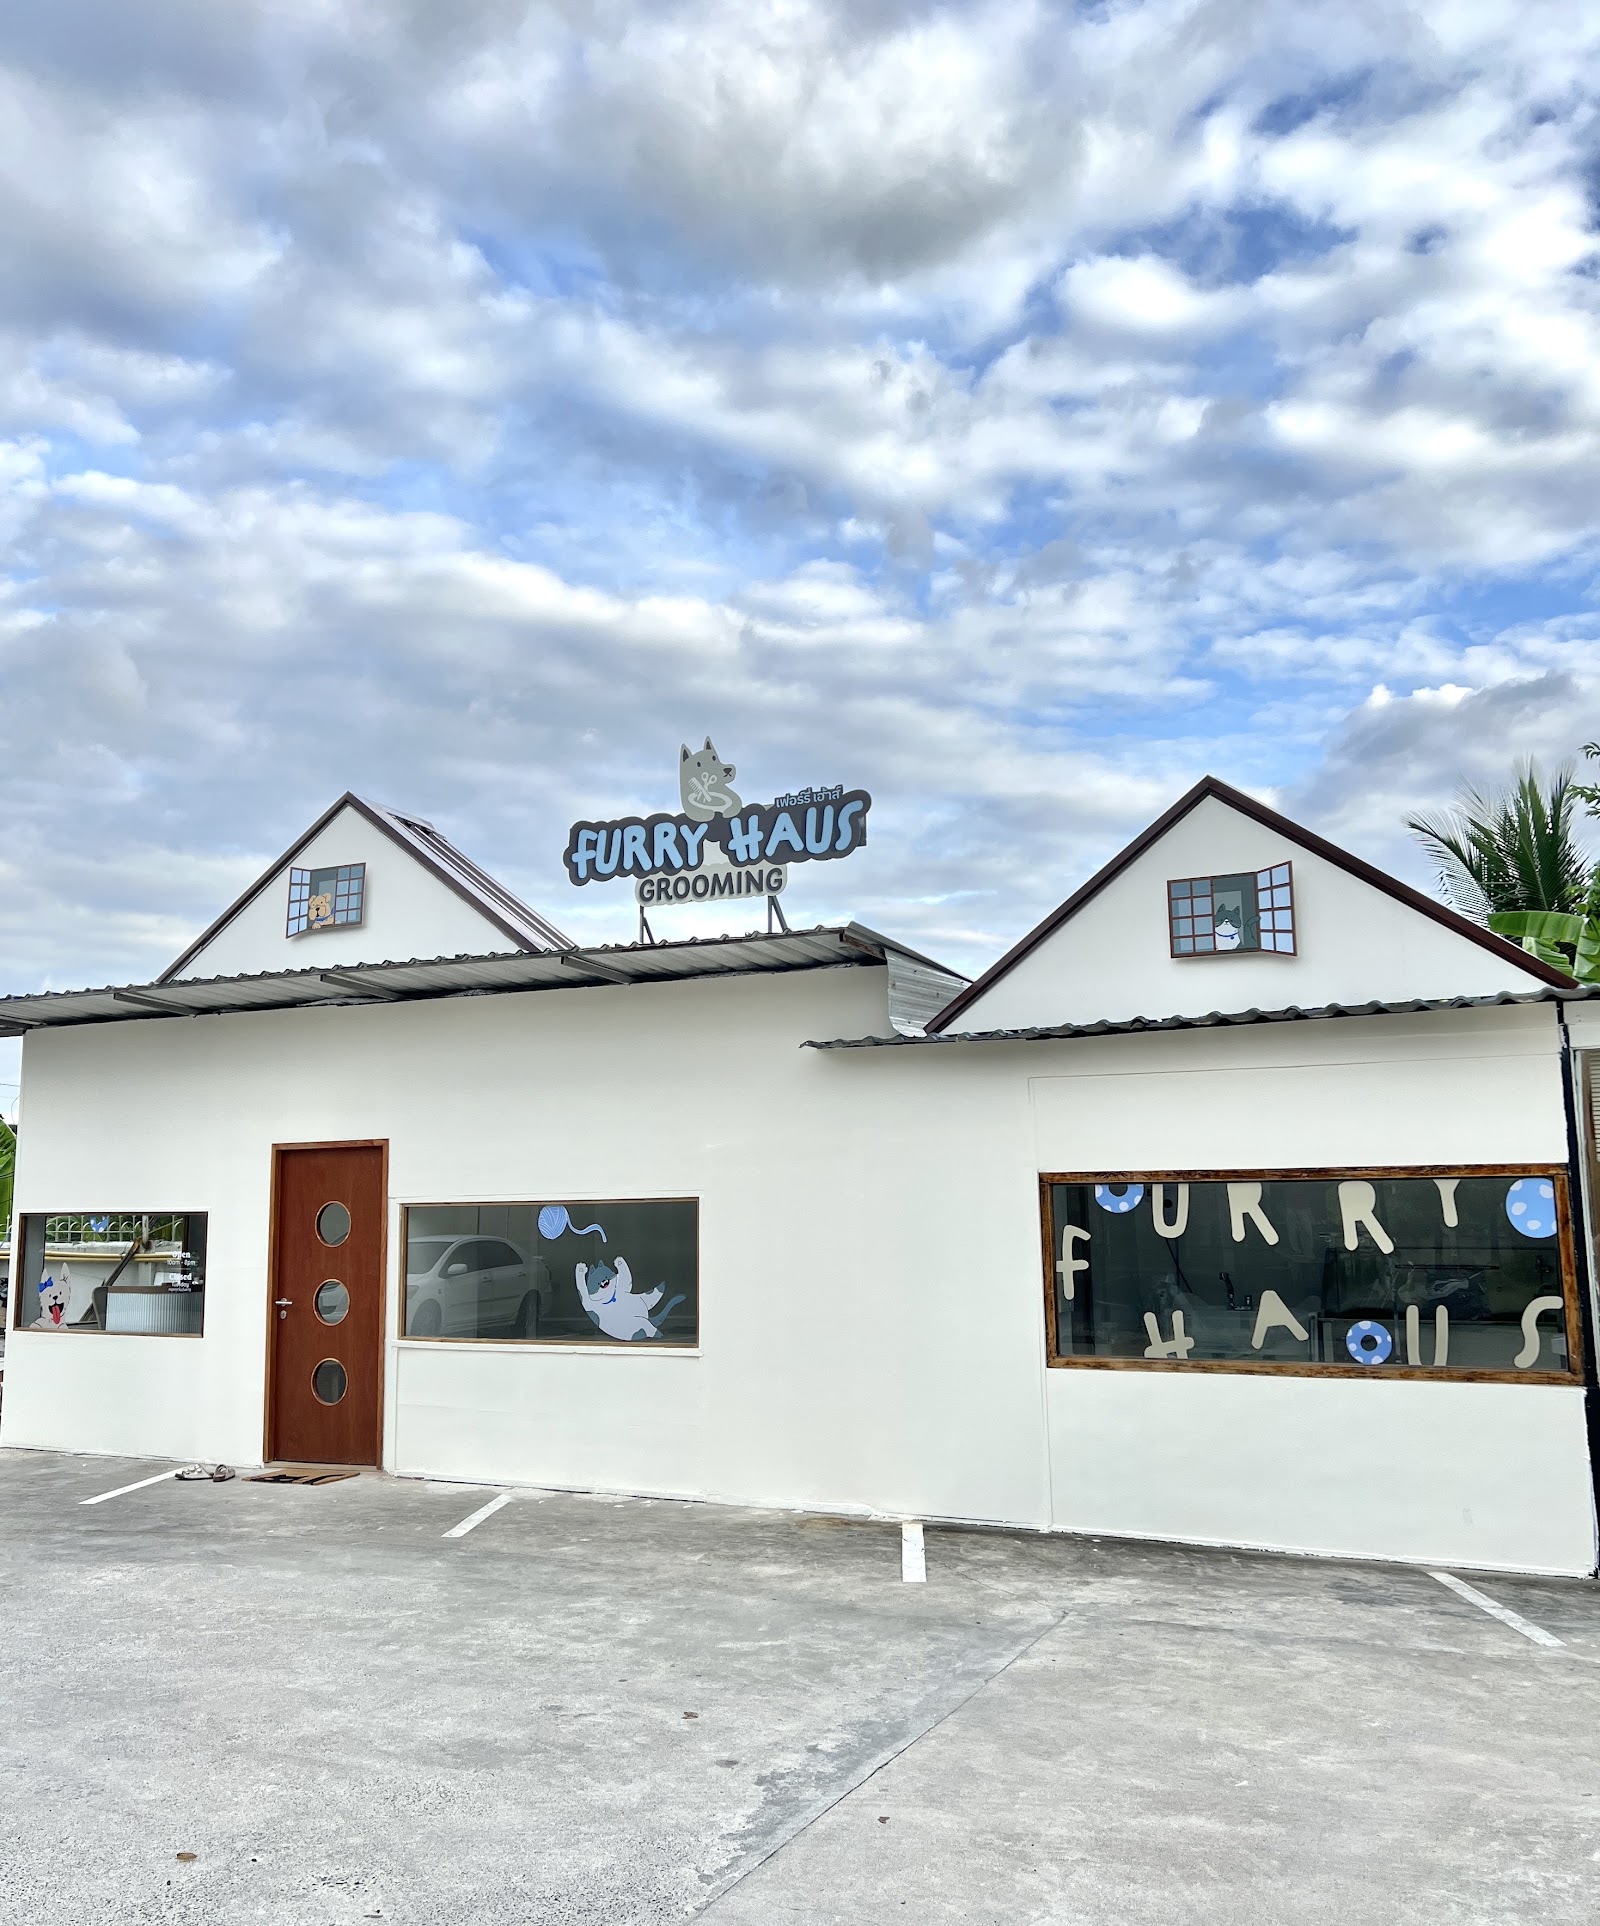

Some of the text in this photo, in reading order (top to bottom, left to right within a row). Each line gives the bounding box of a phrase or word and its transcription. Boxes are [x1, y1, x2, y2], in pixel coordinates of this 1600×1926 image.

[572, 800, 863, 879] FURRY HAUS
[639, 867, 783, 902] GROOMING
[172, 1251, 191, 1260] Open
